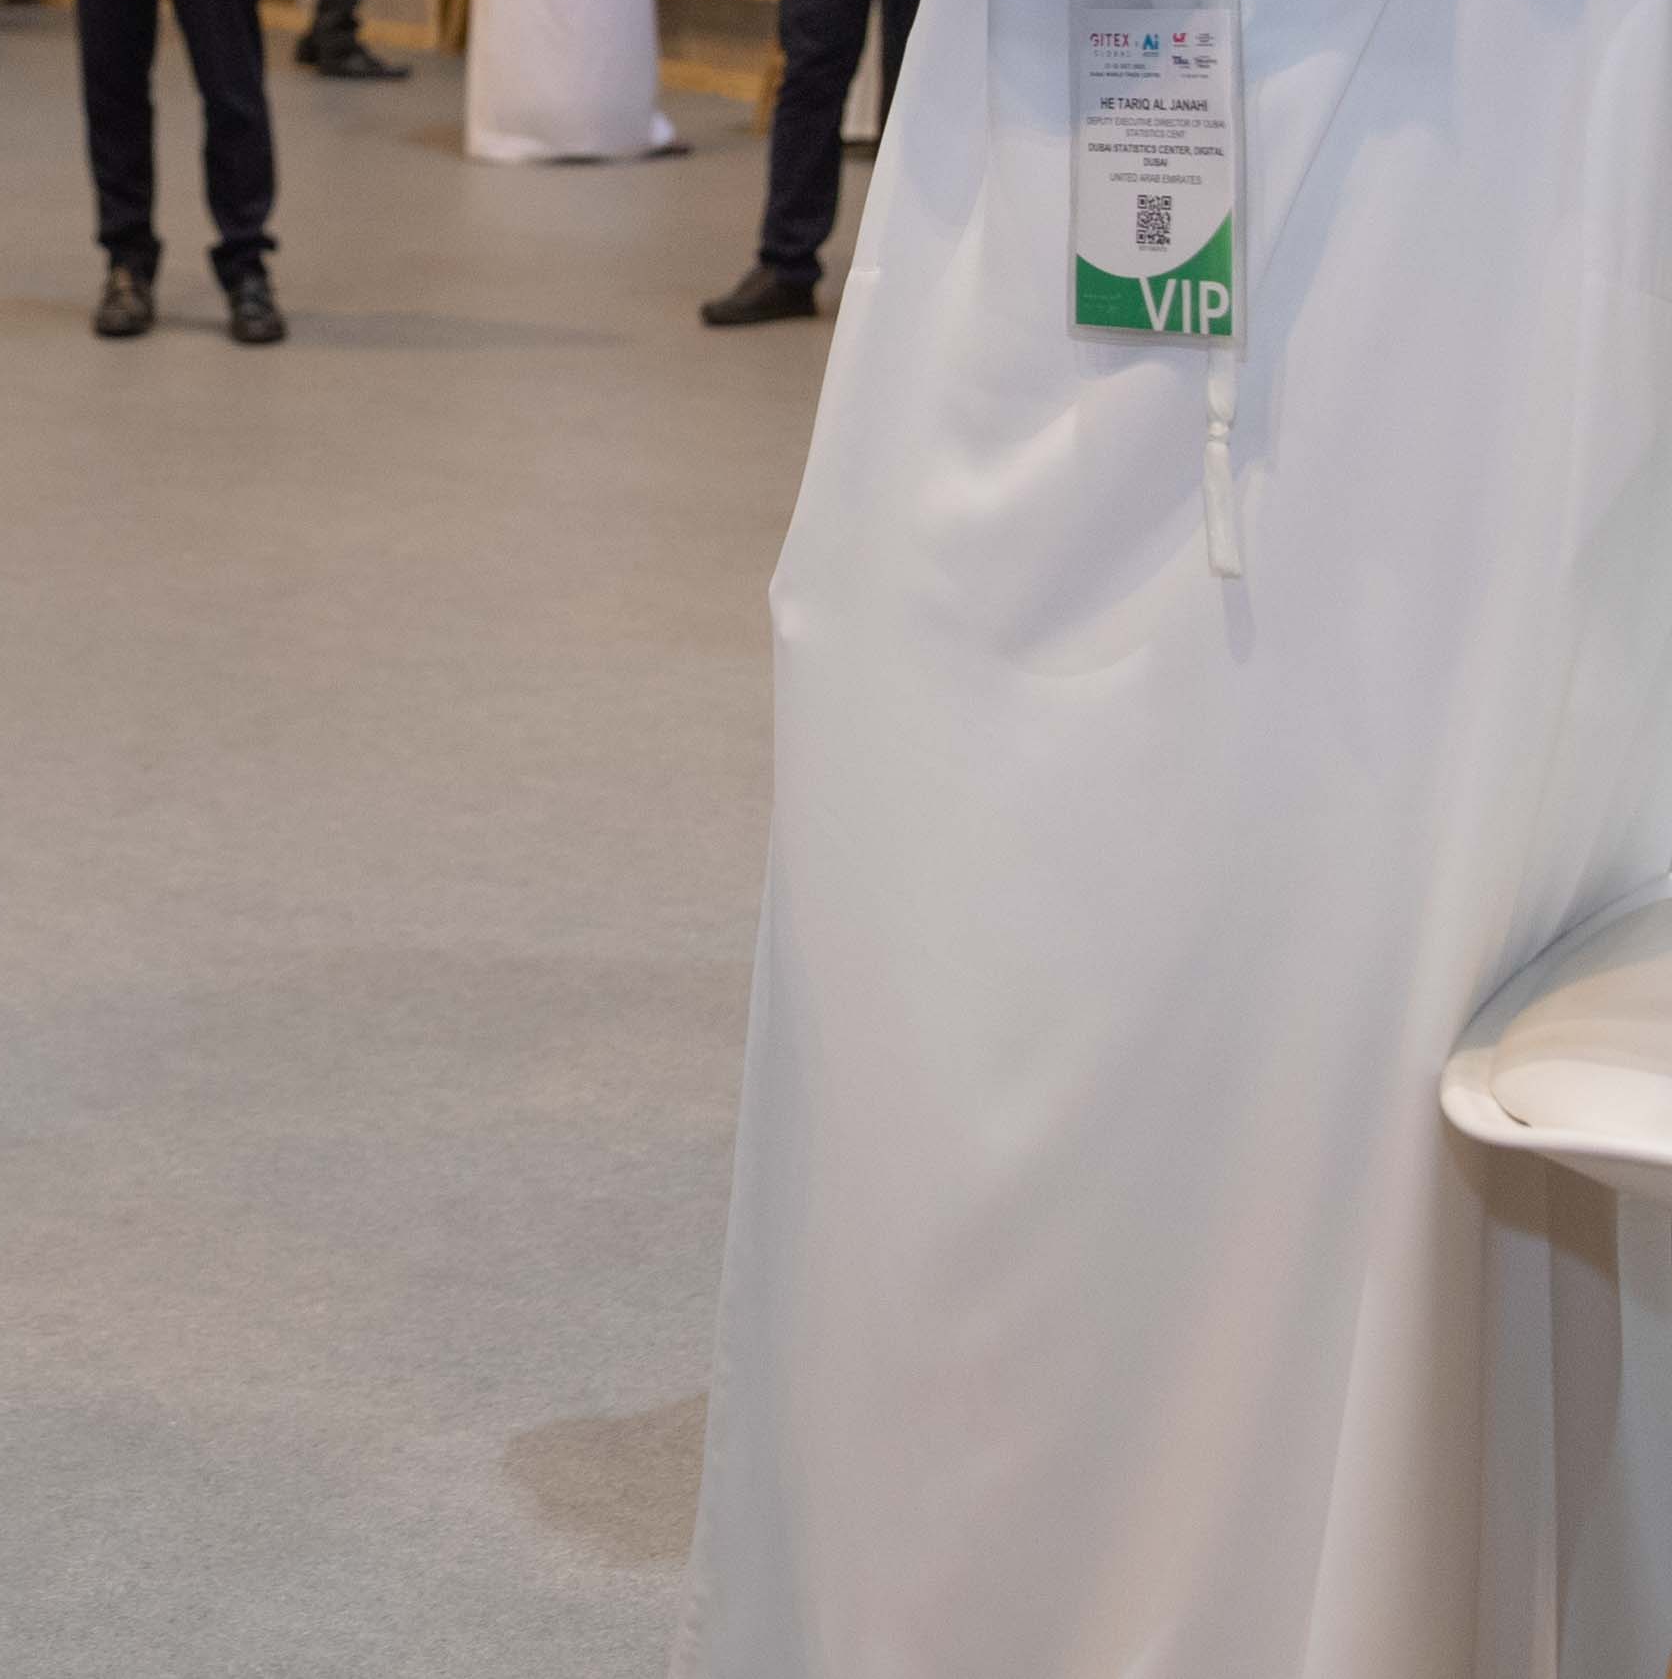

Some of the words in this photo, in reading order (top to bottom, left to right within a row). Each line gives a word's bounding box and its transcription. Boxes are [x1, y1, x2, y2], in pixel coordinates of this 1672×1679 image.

[1089, 32, 1129, 48] GITEX
[1100, 97, 1115, 110] HE
[1118, 98, 1150, 111] TARIQ
[1153, 99, 1166, 111] AL
[1169, 99, 1208, 112] JANAHI
[1126, 129, 1165, 138] STATISTICS
[1088, 143, 1111, 152] DUBAI
[1113, 143, 1157, 154] STATISTICS
[1158, 145, 1192, 156] CENTER,
[1194, 146, 1224, 156] DIGITAL
[1143, 157, 1168, 167] DUBAI
[1110, 173, 1137, 183] UNITED
[1140, 173, 1161, 183] ARAB
[1163, 174, 1201, 184] EMIRATES
[1139, 277, 1229, 335] VIP
